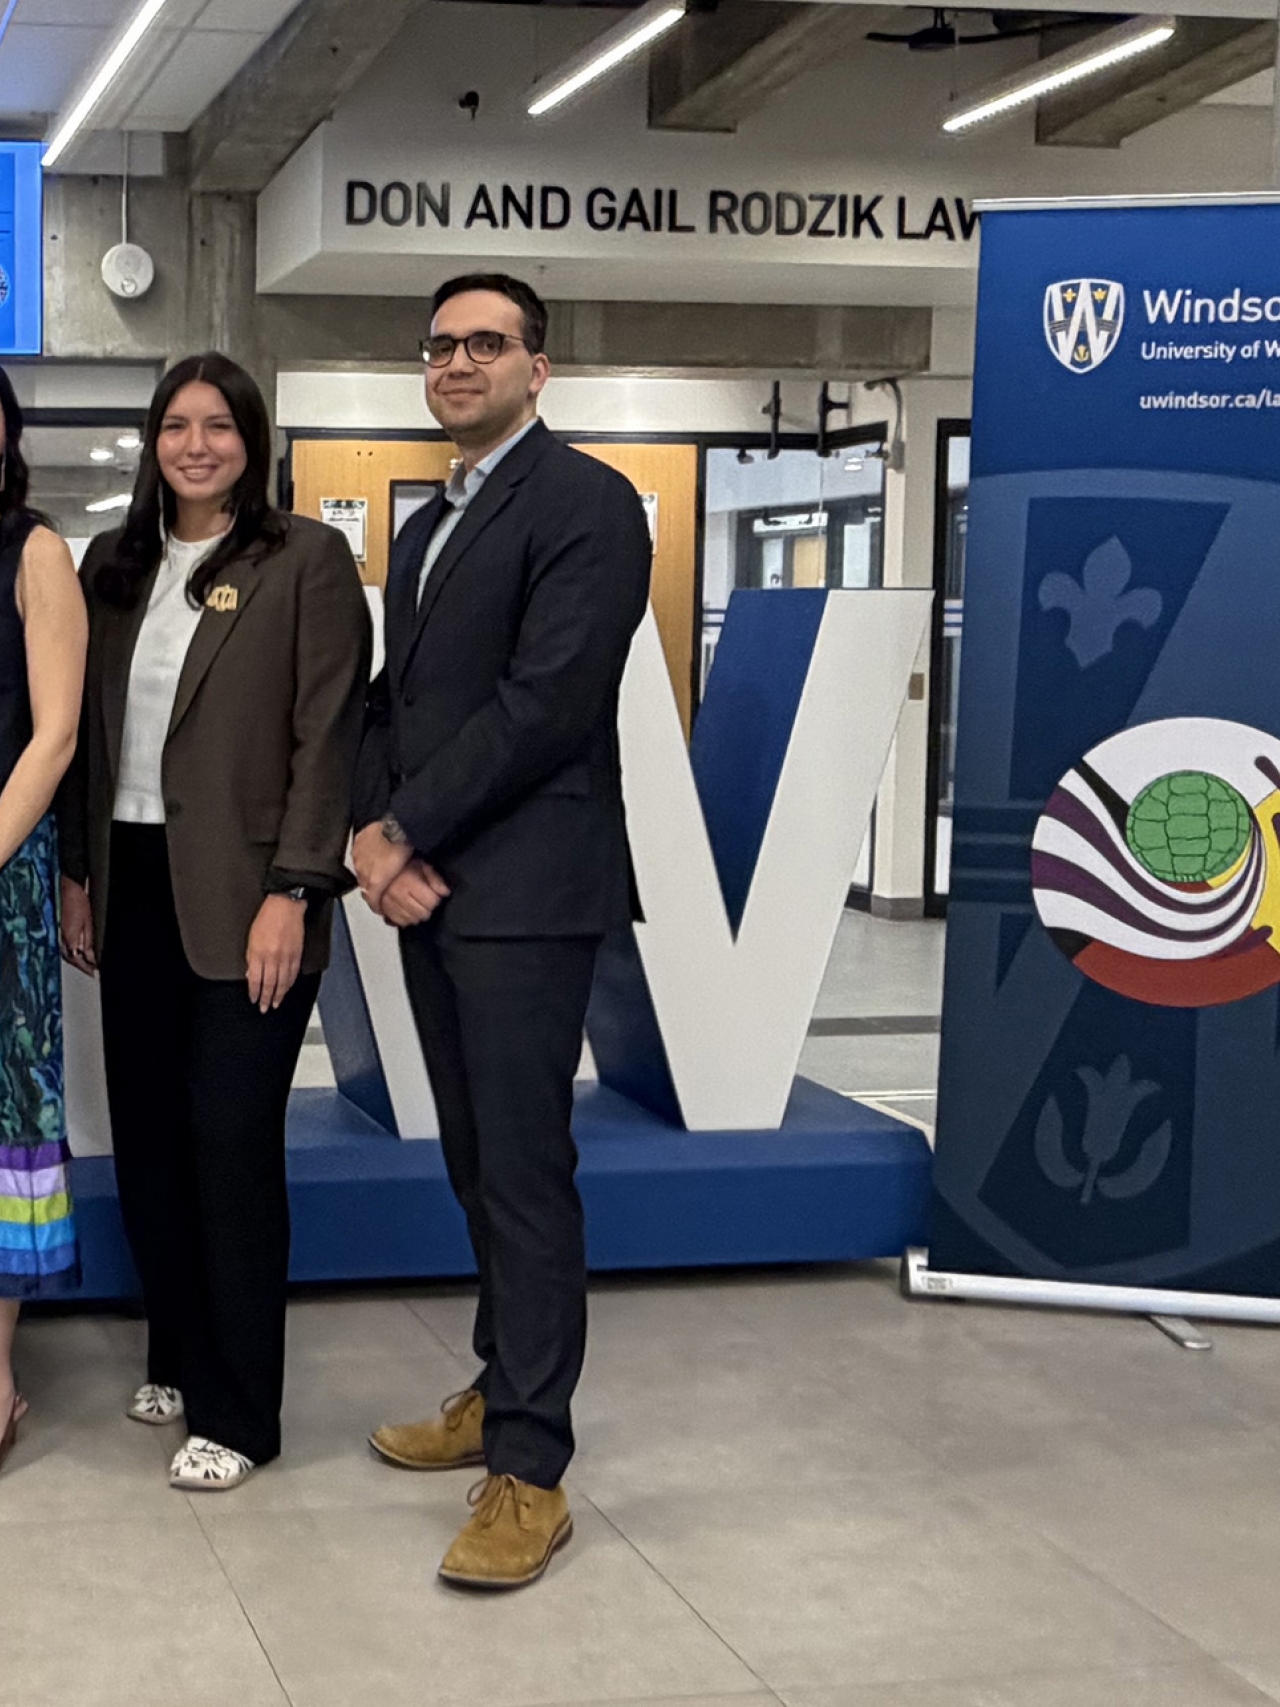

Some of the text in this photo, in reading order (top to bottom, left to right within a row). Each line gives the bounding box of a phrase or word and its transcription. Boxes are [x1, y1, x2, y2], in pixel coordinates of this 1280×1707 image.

[345, 180, 451, 228] DON
[464, 183, 571, 230] AND
[586, 186, 696, 233] GAIL
[708, 189, 885, 240] RODZIK
[1143, 286, 1280, 324] Windso
[1140, 341, 1237, 363] University
[1240, 340, 1262, 358] of
[1139, 388, 1280, 410] uwindsor.ca/la
